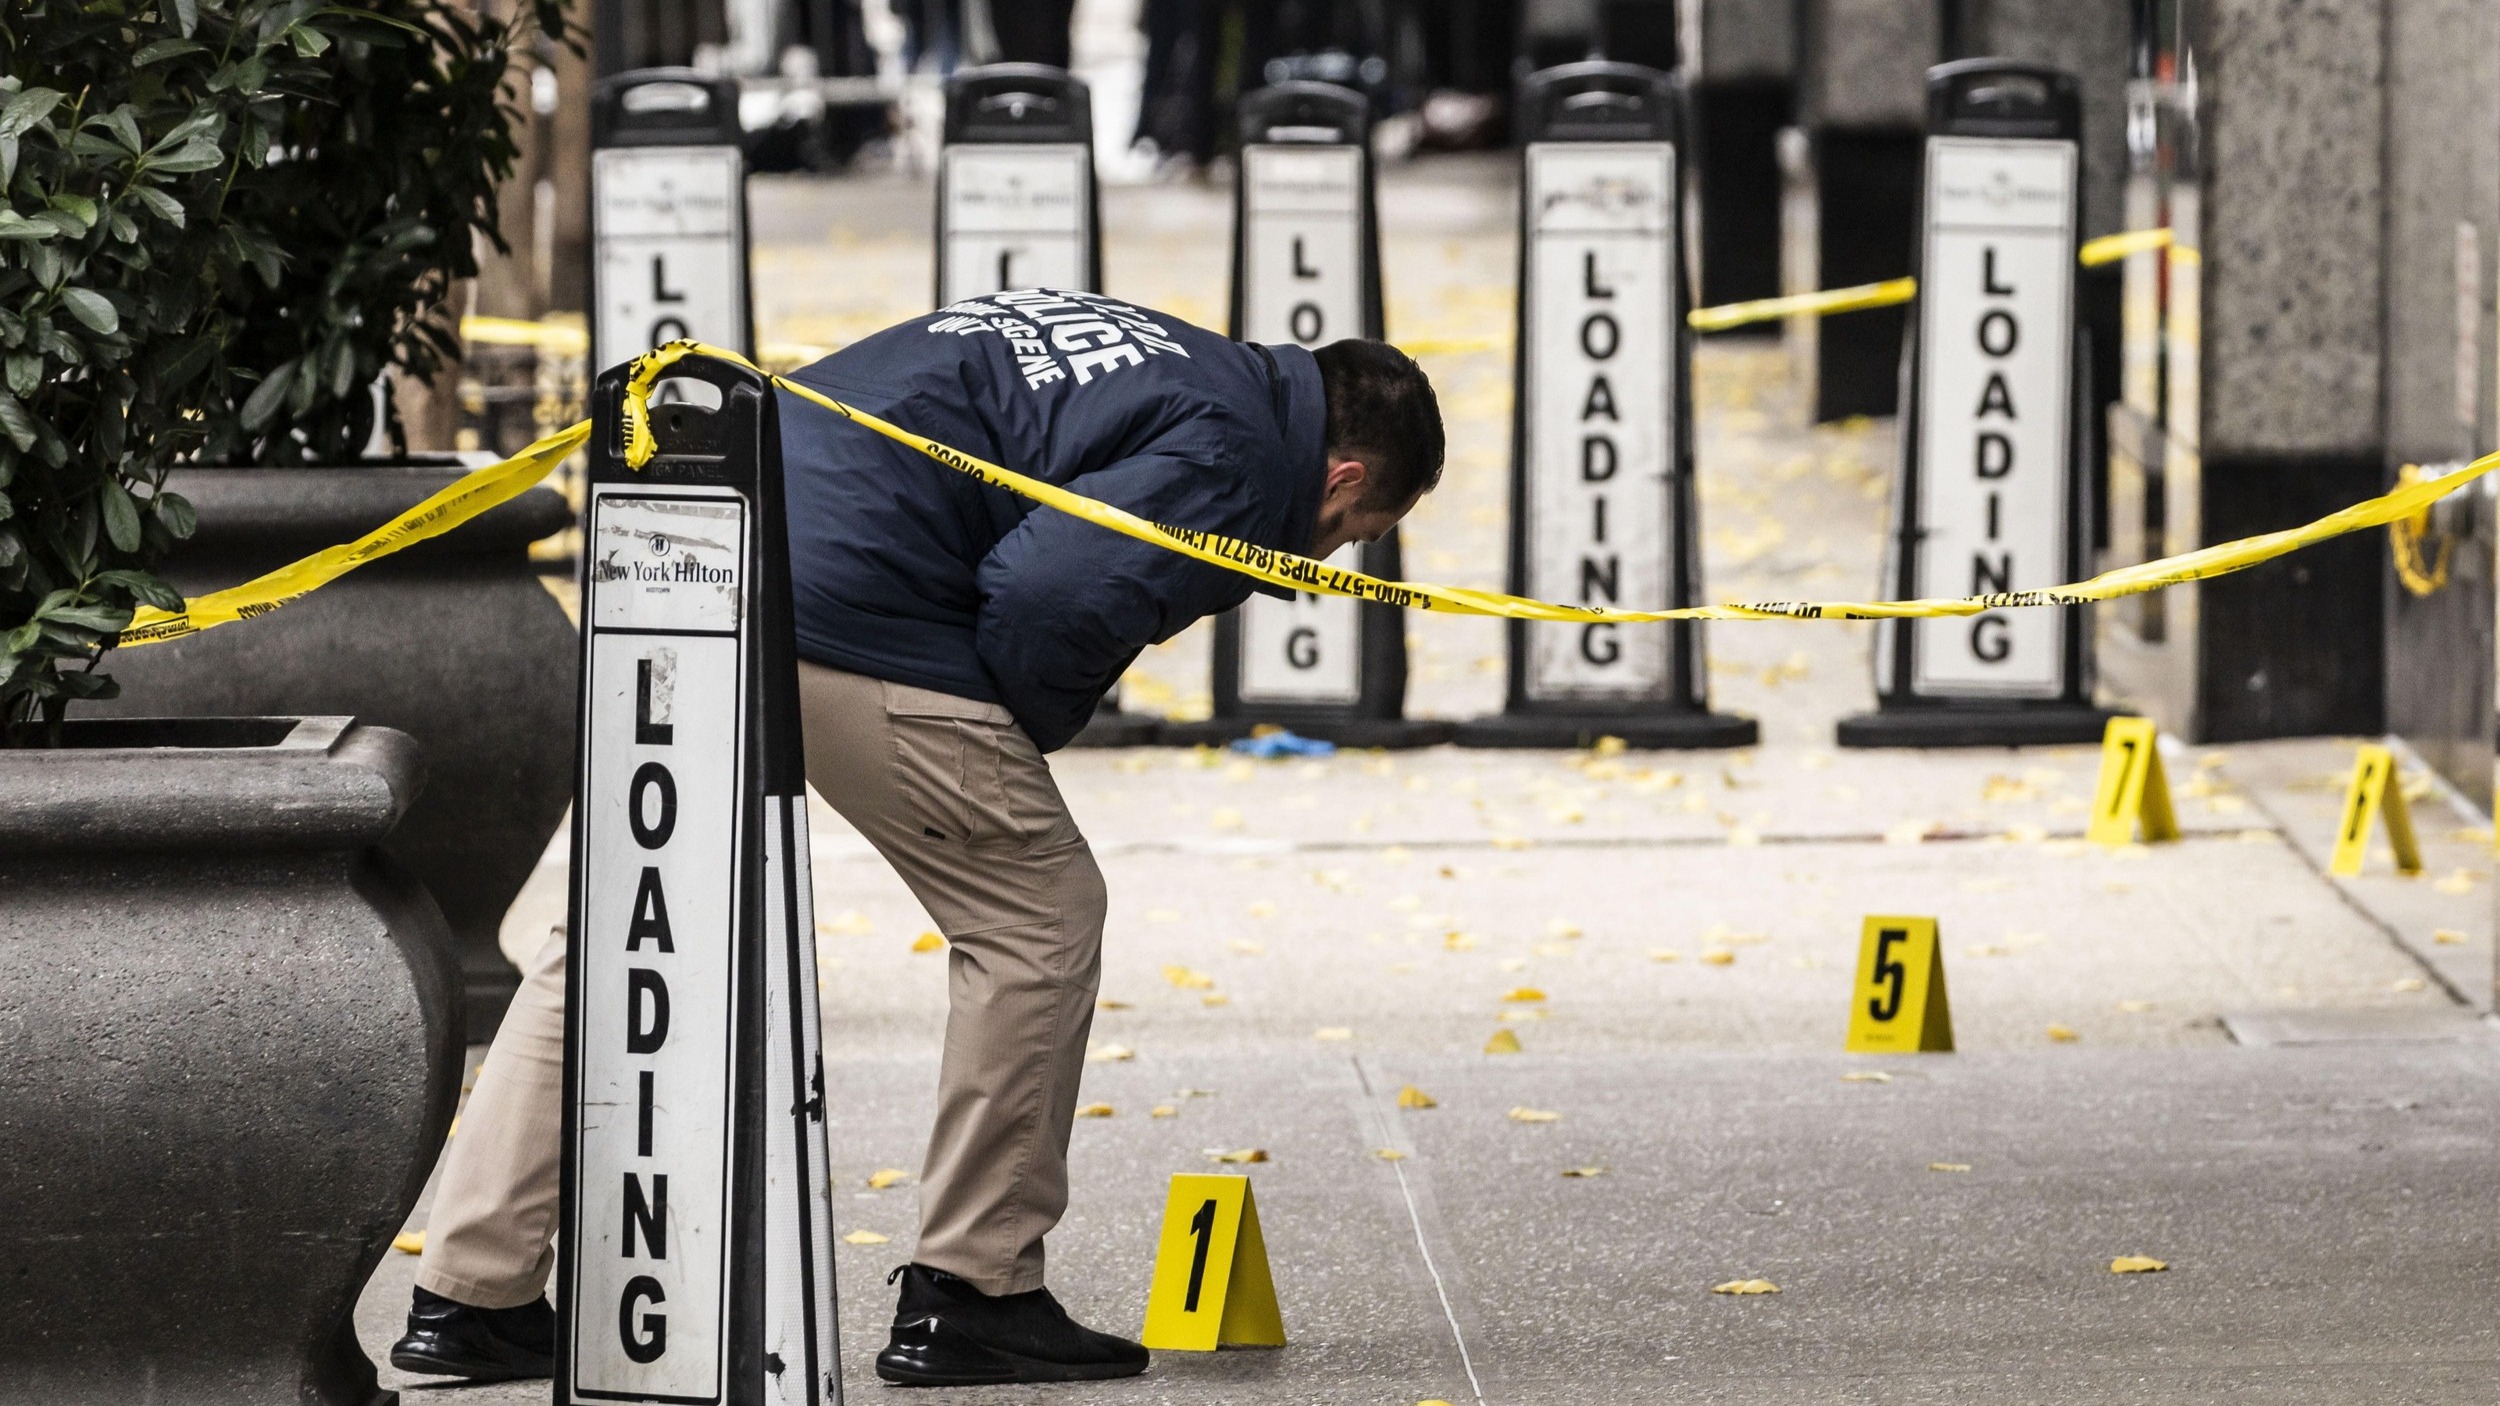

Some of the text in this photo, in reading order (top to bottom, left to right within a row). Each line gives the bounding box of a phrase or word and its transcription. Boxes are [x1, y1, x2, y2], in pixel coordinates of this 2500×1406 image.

[990, 317, 1066, 391] SCENE
[1579, 252, 1620, 667] LOADING
[1971, 245, 2019, 663] LOADING
[600, 560, 734, 583] New York Hilton
[2109, 740, 2135, 817] 7
[618, 658, 678, 1365] LOADING
[1868, 929, 1908, 1022] 5
[1183, 1199, 1218, 1313] 1
